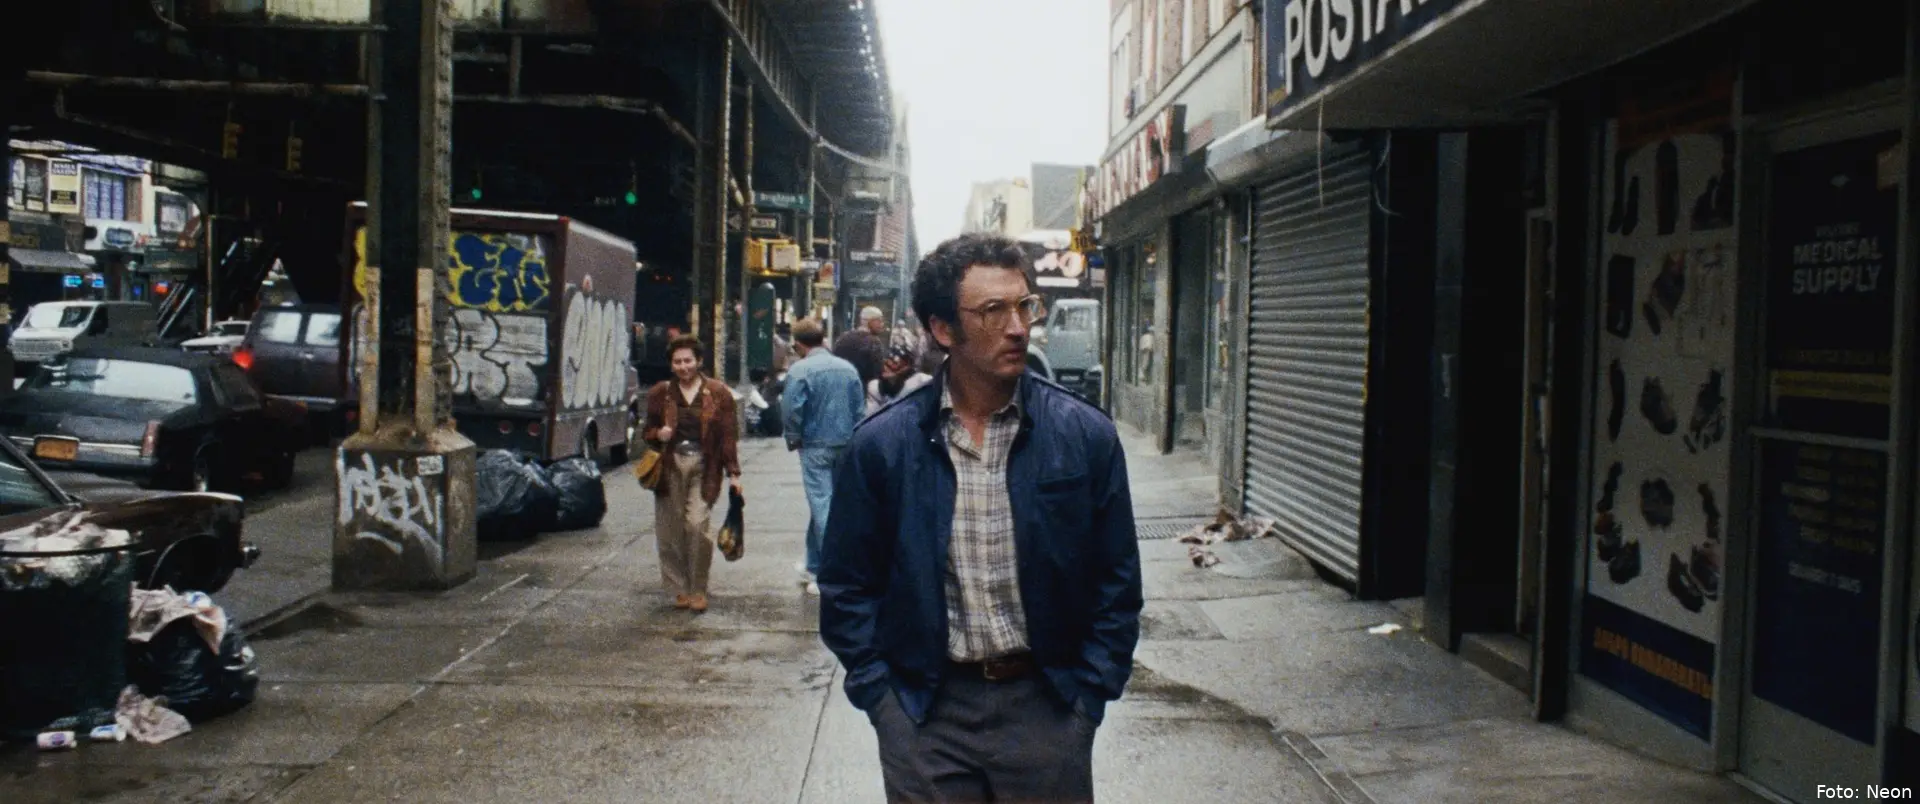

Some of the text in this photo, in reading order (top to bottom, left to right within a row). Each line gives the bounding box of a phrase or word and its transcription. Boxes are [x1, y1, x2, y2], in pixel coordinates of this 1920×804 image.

[1285, 0, 1433, 95] POS
[1793, 236, 1883, 265] MEDICAL
[1792, 263, 1882, 294] SUPPLY
